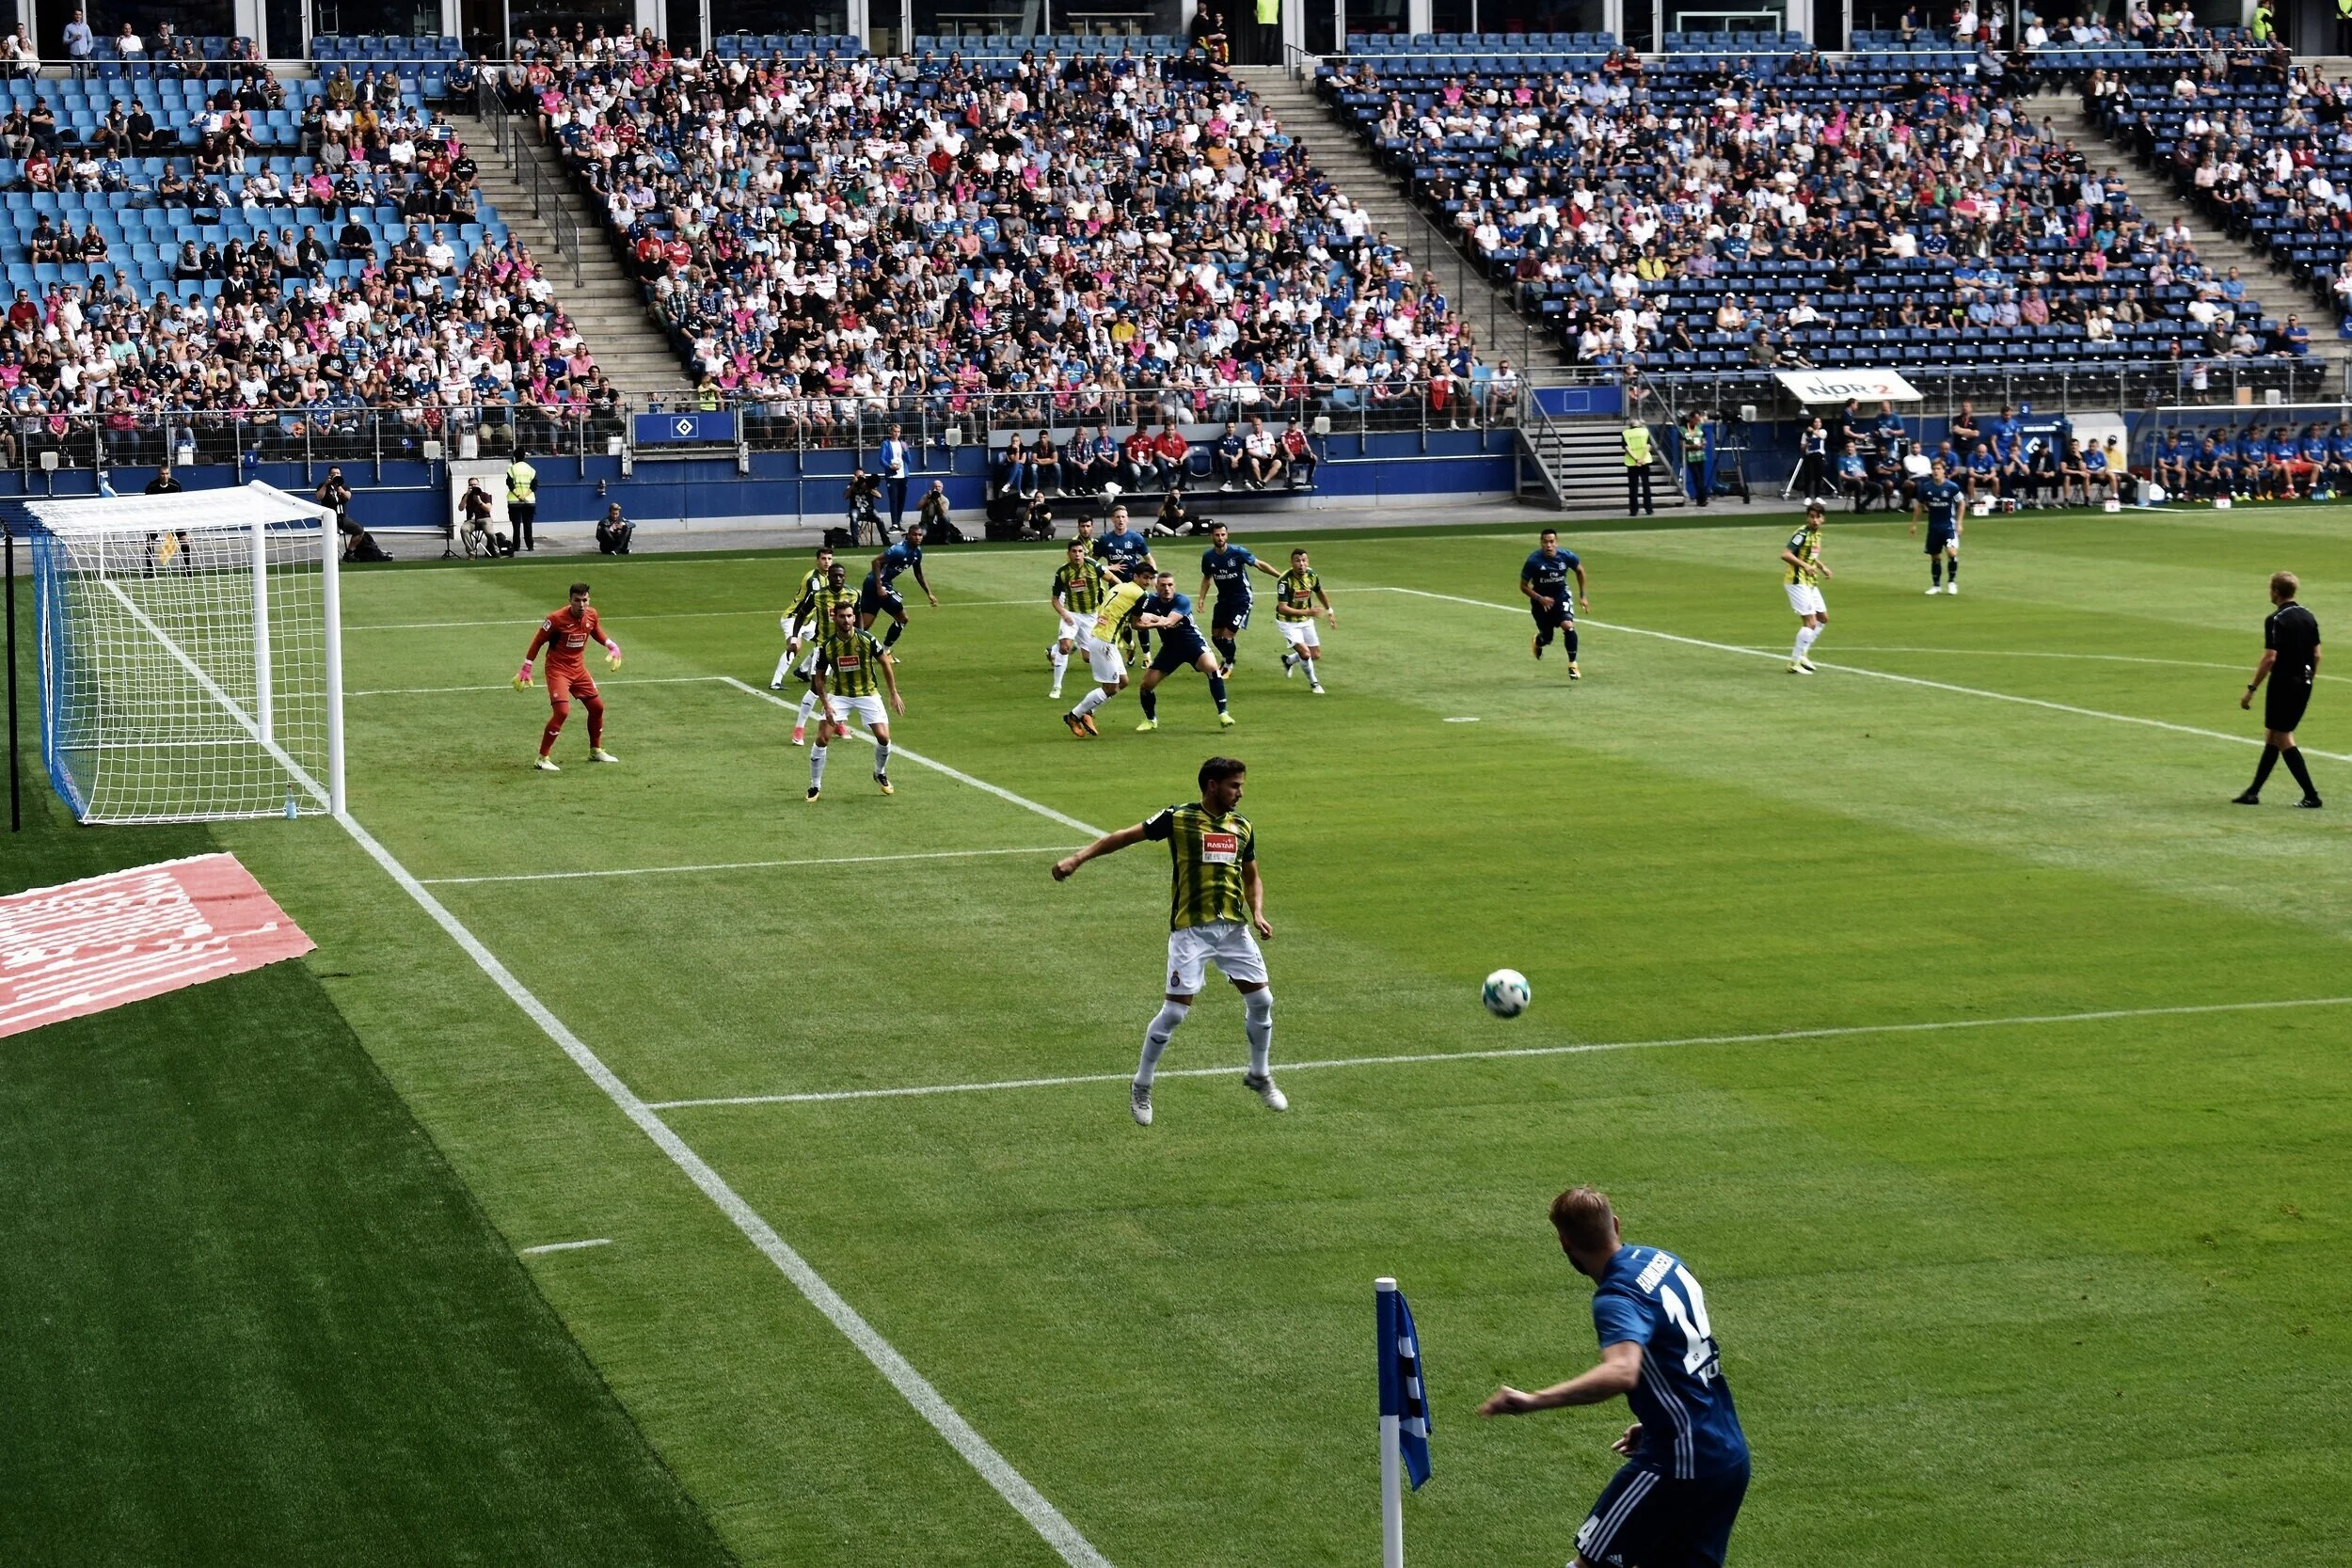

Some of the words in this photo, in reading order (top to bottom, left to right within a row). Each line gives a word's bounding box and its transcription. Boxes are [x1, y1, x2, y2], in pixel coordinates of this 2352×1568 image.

[1806, 377, 1872, 397] NDR
[1873, 384, 1894, 395] 2
[2022, 405, 2028, 414] 3
[941, 437, 946, 446] 2
[1104, 591, 1120, 609] 7
[1232, 614, 1242, 626] 5
